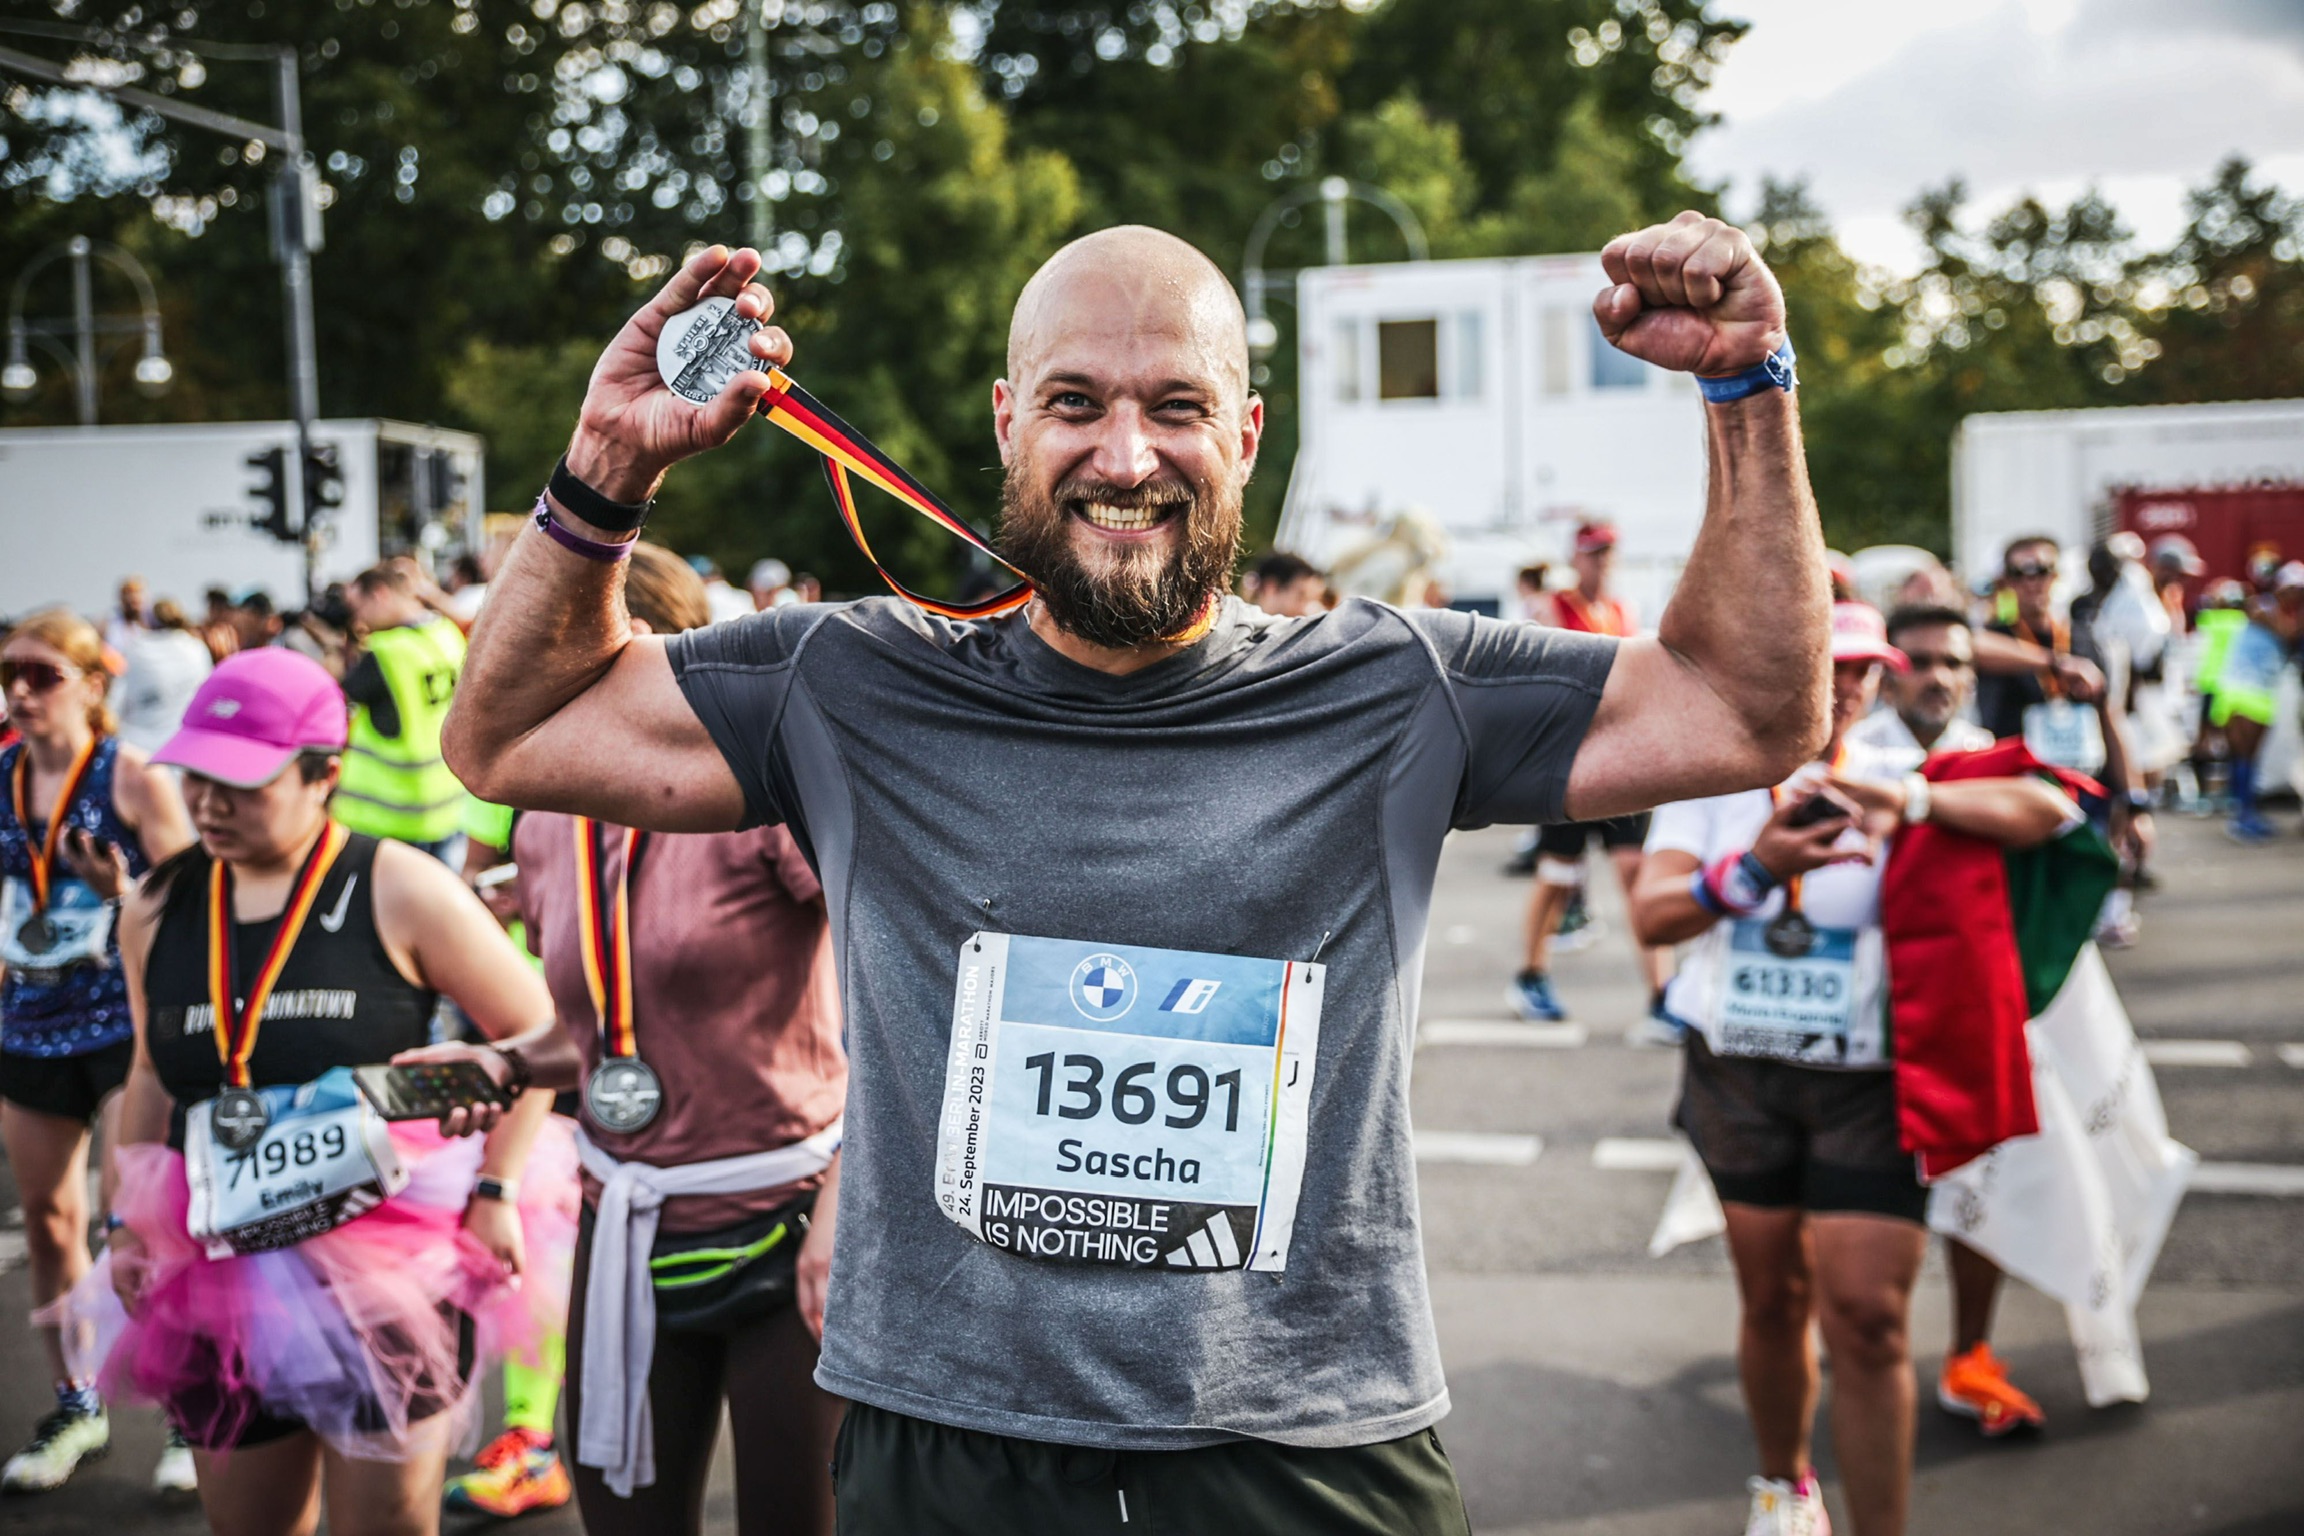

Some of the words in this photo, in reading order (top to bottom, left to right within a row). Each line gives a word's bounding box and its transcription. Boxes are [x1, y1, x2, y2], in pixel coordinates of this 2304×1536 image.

[1081, 957, 1130, 978] BMW
[1733, 966, 1843, 1002] 61330
[946, 965, 980, 1139] BERLIN-MARATHON
[968, 1066, 985, 1105] 2023
[1025, 1051, 1241, 1132] 13691
[225, 1125, 345, 1192] 71989
[960, 1107, 981, 1190] September
[1057, 1139, 1200, 1184] Sascha
[959, 1193, 971, 1217] 24.
[985, 1189, 1170, 1232] IMPOSSIBLE
[985, 1221, 1010, 1248] IS
[1017, 1225, 1159, 1264] NOTHING
